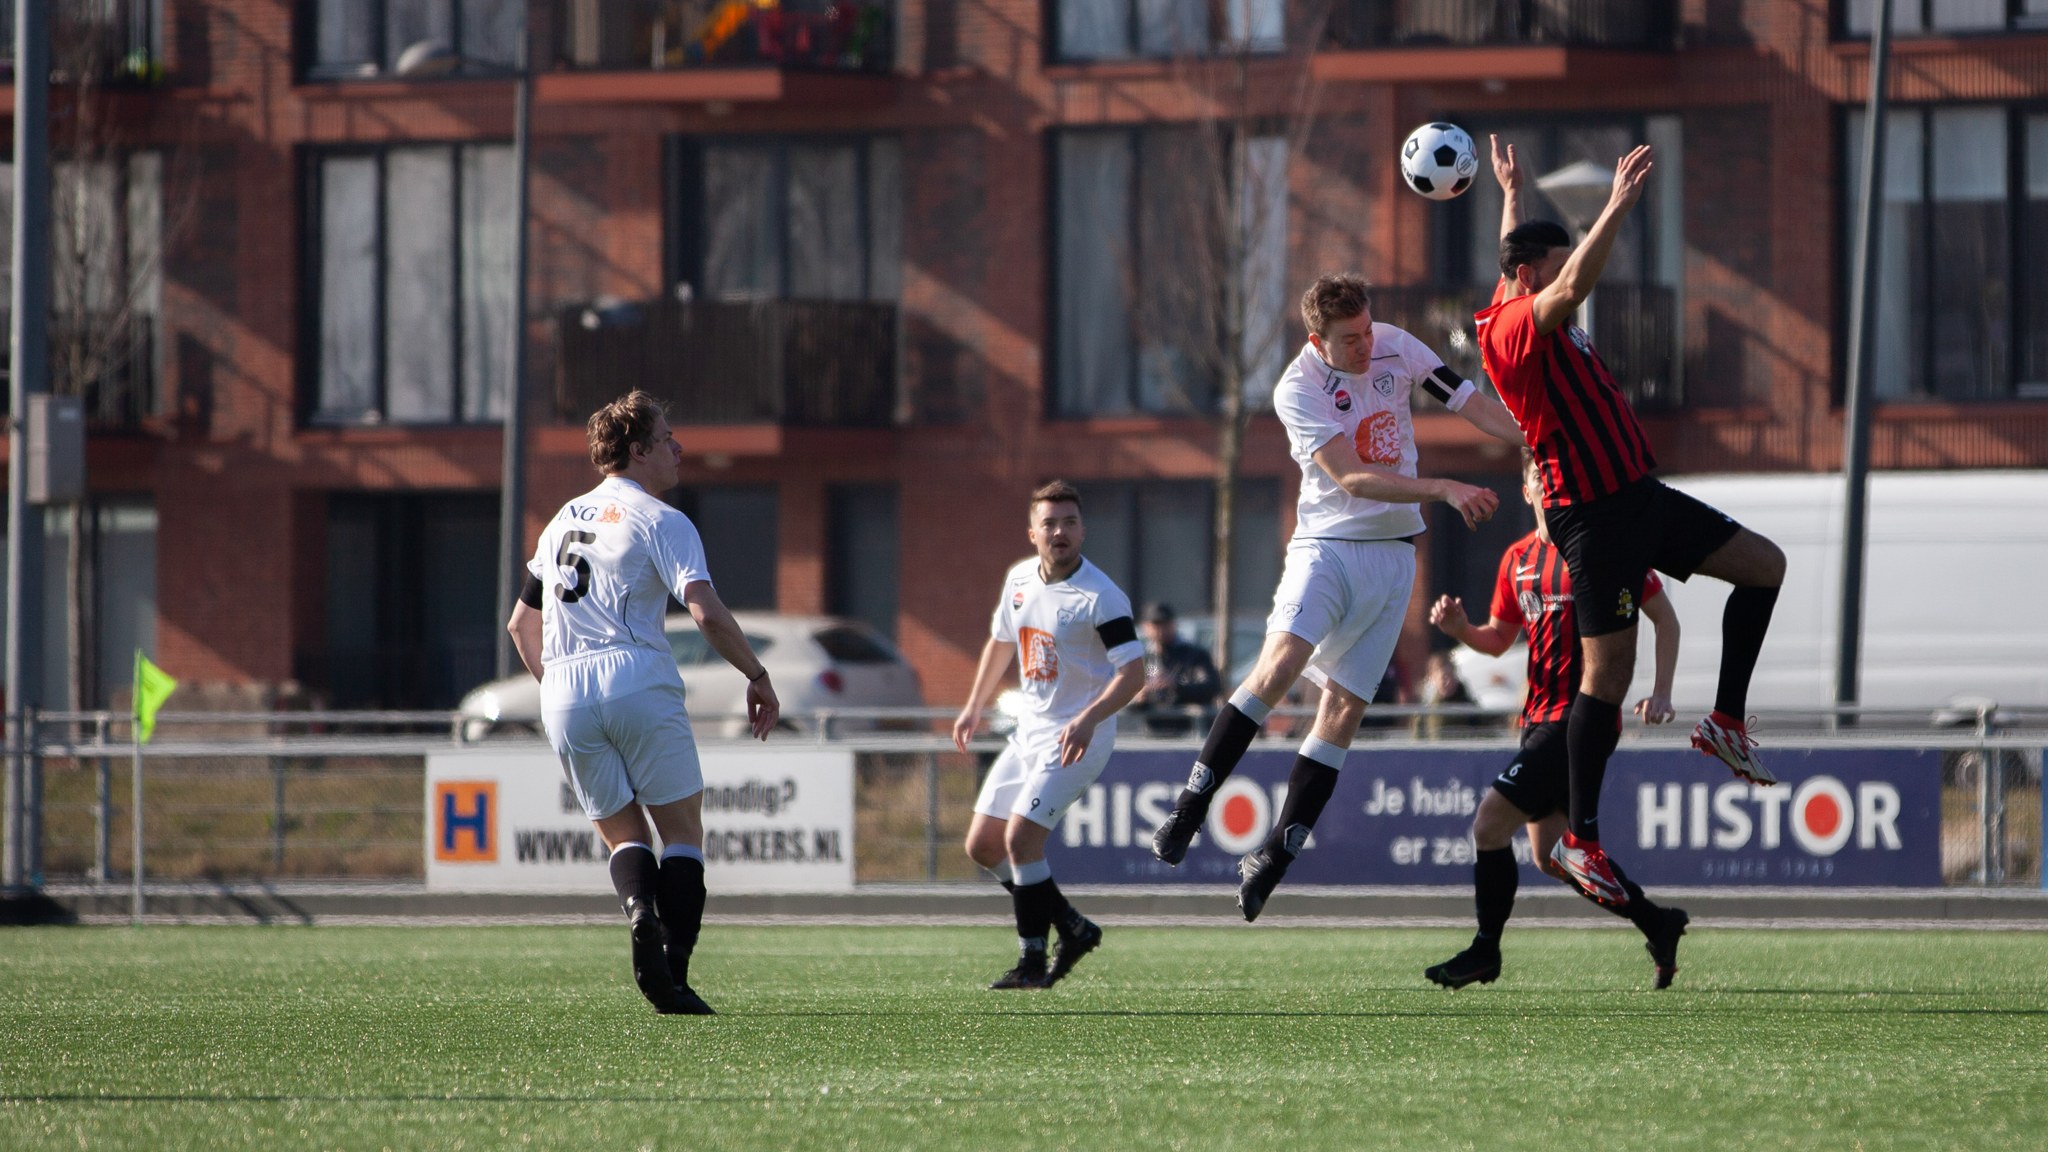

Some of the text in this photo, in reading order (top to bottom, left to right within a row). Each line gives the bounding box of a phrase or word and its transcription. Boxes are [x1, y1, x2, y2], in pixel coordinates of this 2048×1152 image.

[555, 530, 596, 603] 5
[1365, 776, 1476, 816] Je huis
[1509, 763, 1522, 777] 6
[1063, 775, 1315, 856] HISO
[1637, 775, 1902, 856] HISTOR
[1391, 836, 1427, 865] er
